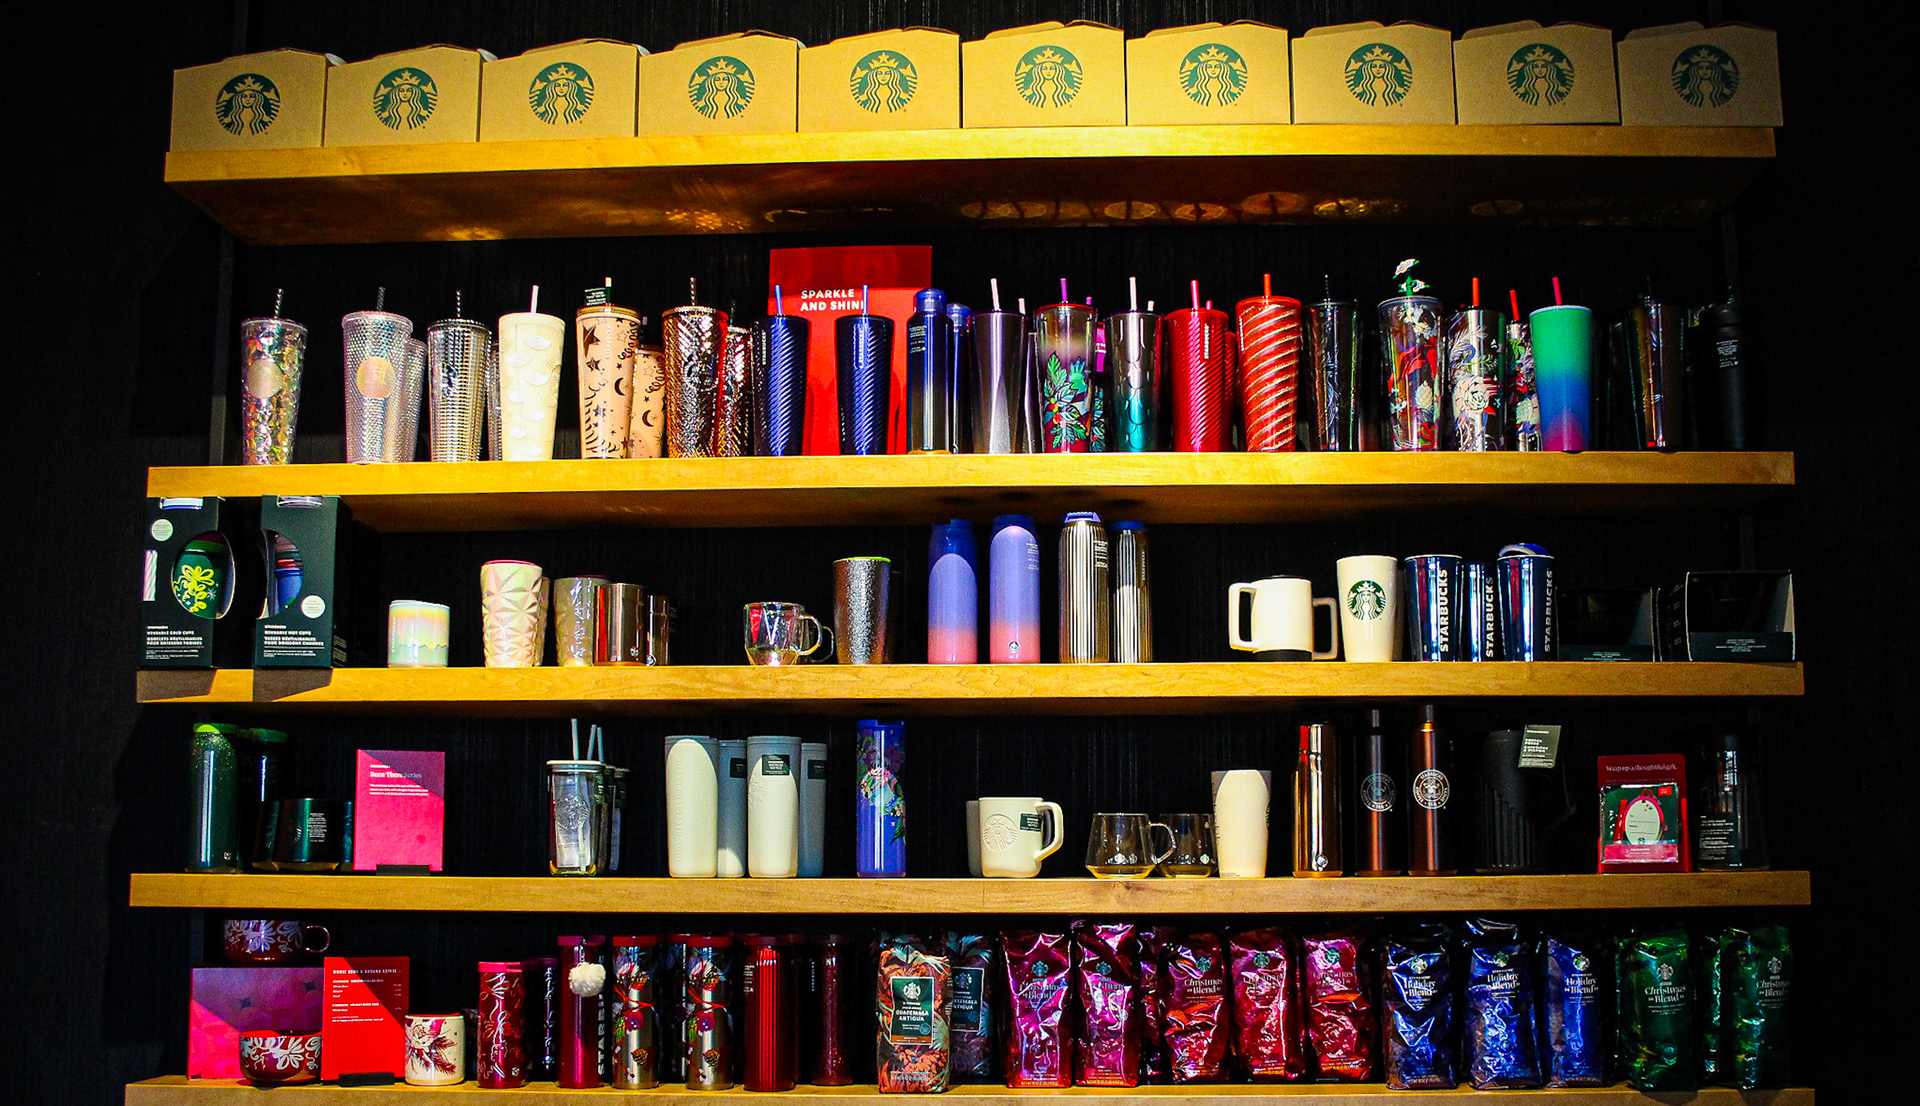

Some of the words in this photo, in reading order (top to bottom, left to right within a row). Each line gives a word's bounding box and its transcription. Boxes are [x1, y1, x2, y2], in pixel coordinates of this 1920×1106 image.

[801, 288, 855, 299] SPARKLE
[800, 302, 825, 312] AND
[830, 300, 864, 311] SHIN
[1439, 568, 1449, 653] STARBUCKS
[1544, 570, 1553, 652] STARBUCKS
[1485, 577, 1494, 657] STARBUCKS
[1184, 978, 1223, 987] Christmas
[1487, 973, 1519, 983] Holiday
[1566, 976, 1598, 986] Holiday
[1403, 978, 1436, 990] Holiday
[1492, 980, 1517, 990] Blend
[1570, 984, 1596, 994] Blend
[1756, 979, 1790, 990] Christmas
[1192, 986, 1217, 995] Blend
[1408, 988, 1433, 997] Blend
[1644, 985, 1687, 996] Christmas
[1764, 988, 1786, 997] Blend
[1654, 994, 1680, 1004] Blend
[597, 955, 605, 1075] STARBUS
